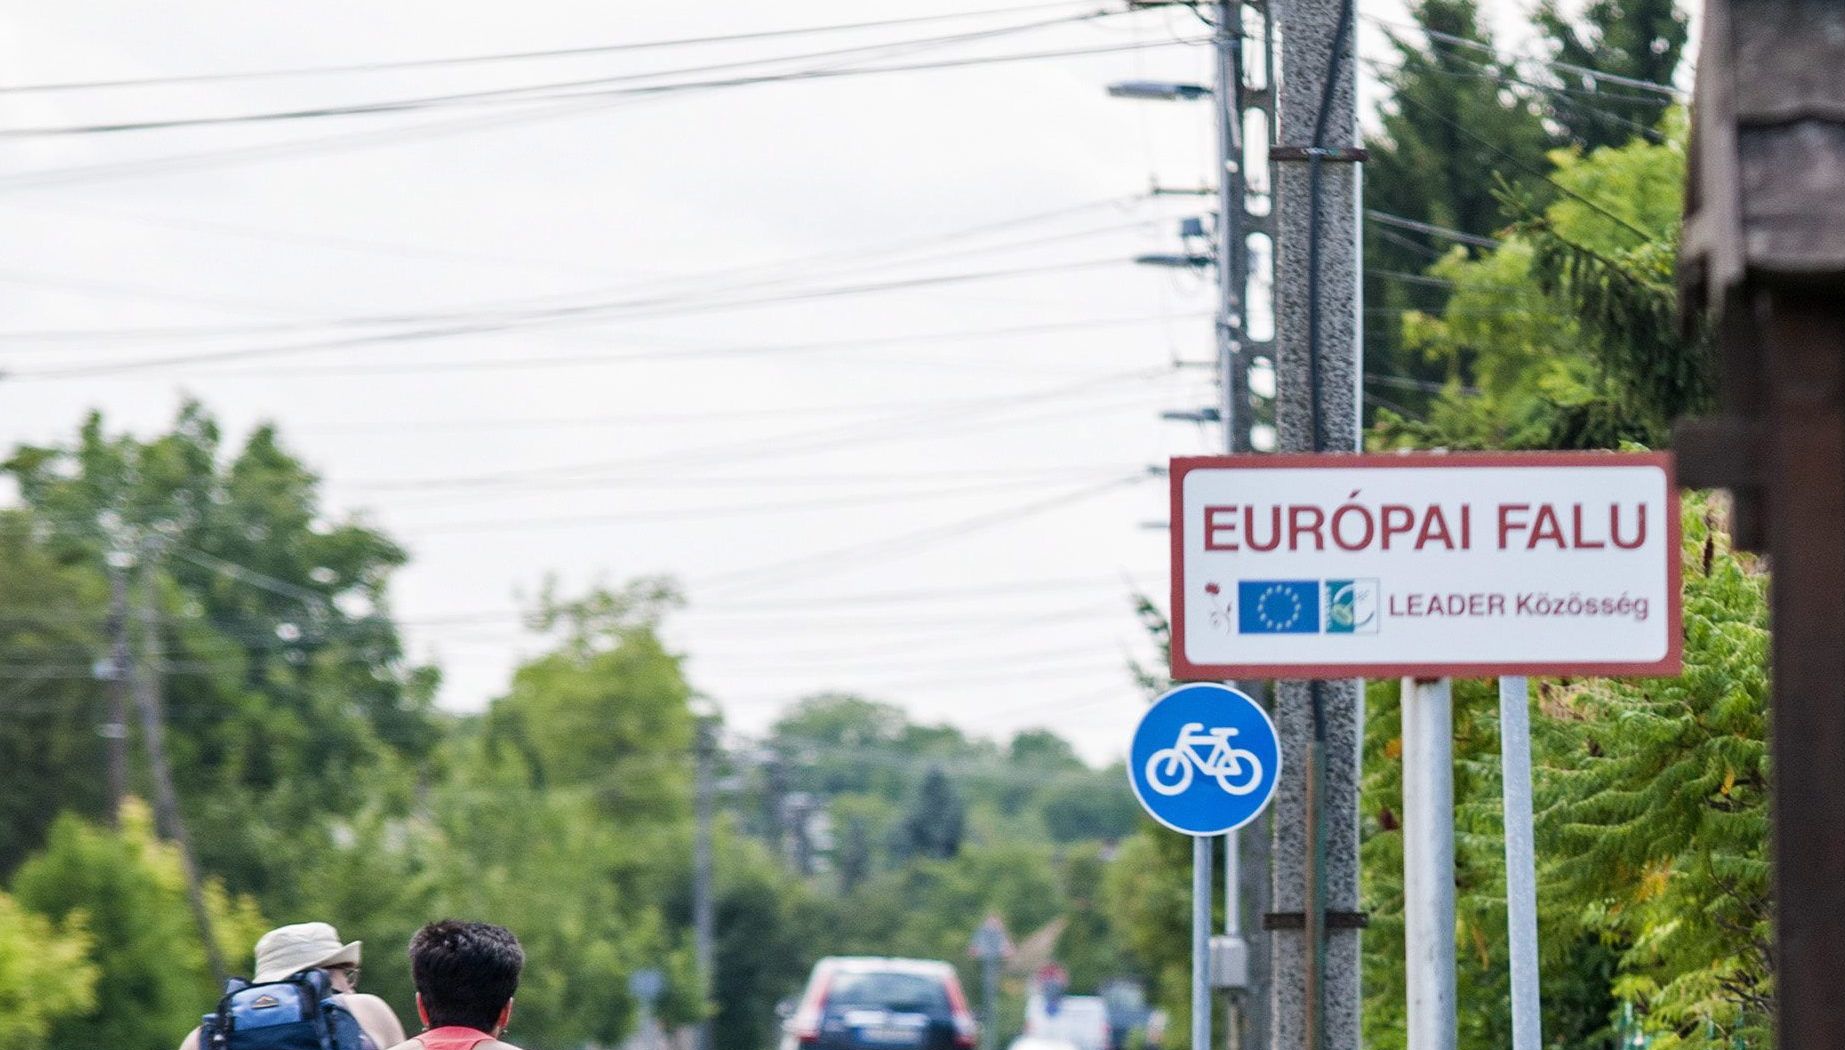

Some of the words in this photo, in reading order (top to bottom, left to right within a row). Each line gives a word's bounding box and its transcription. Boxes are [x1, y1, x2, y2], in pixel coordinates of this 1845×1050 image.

[1203, 489, 1470, 552] EURÓPAI
[1497, 502, 1648, 550] FALU
[1389, 594, 1505, 617] LEADER
[1516, 592, 1650, 620] Közösség
